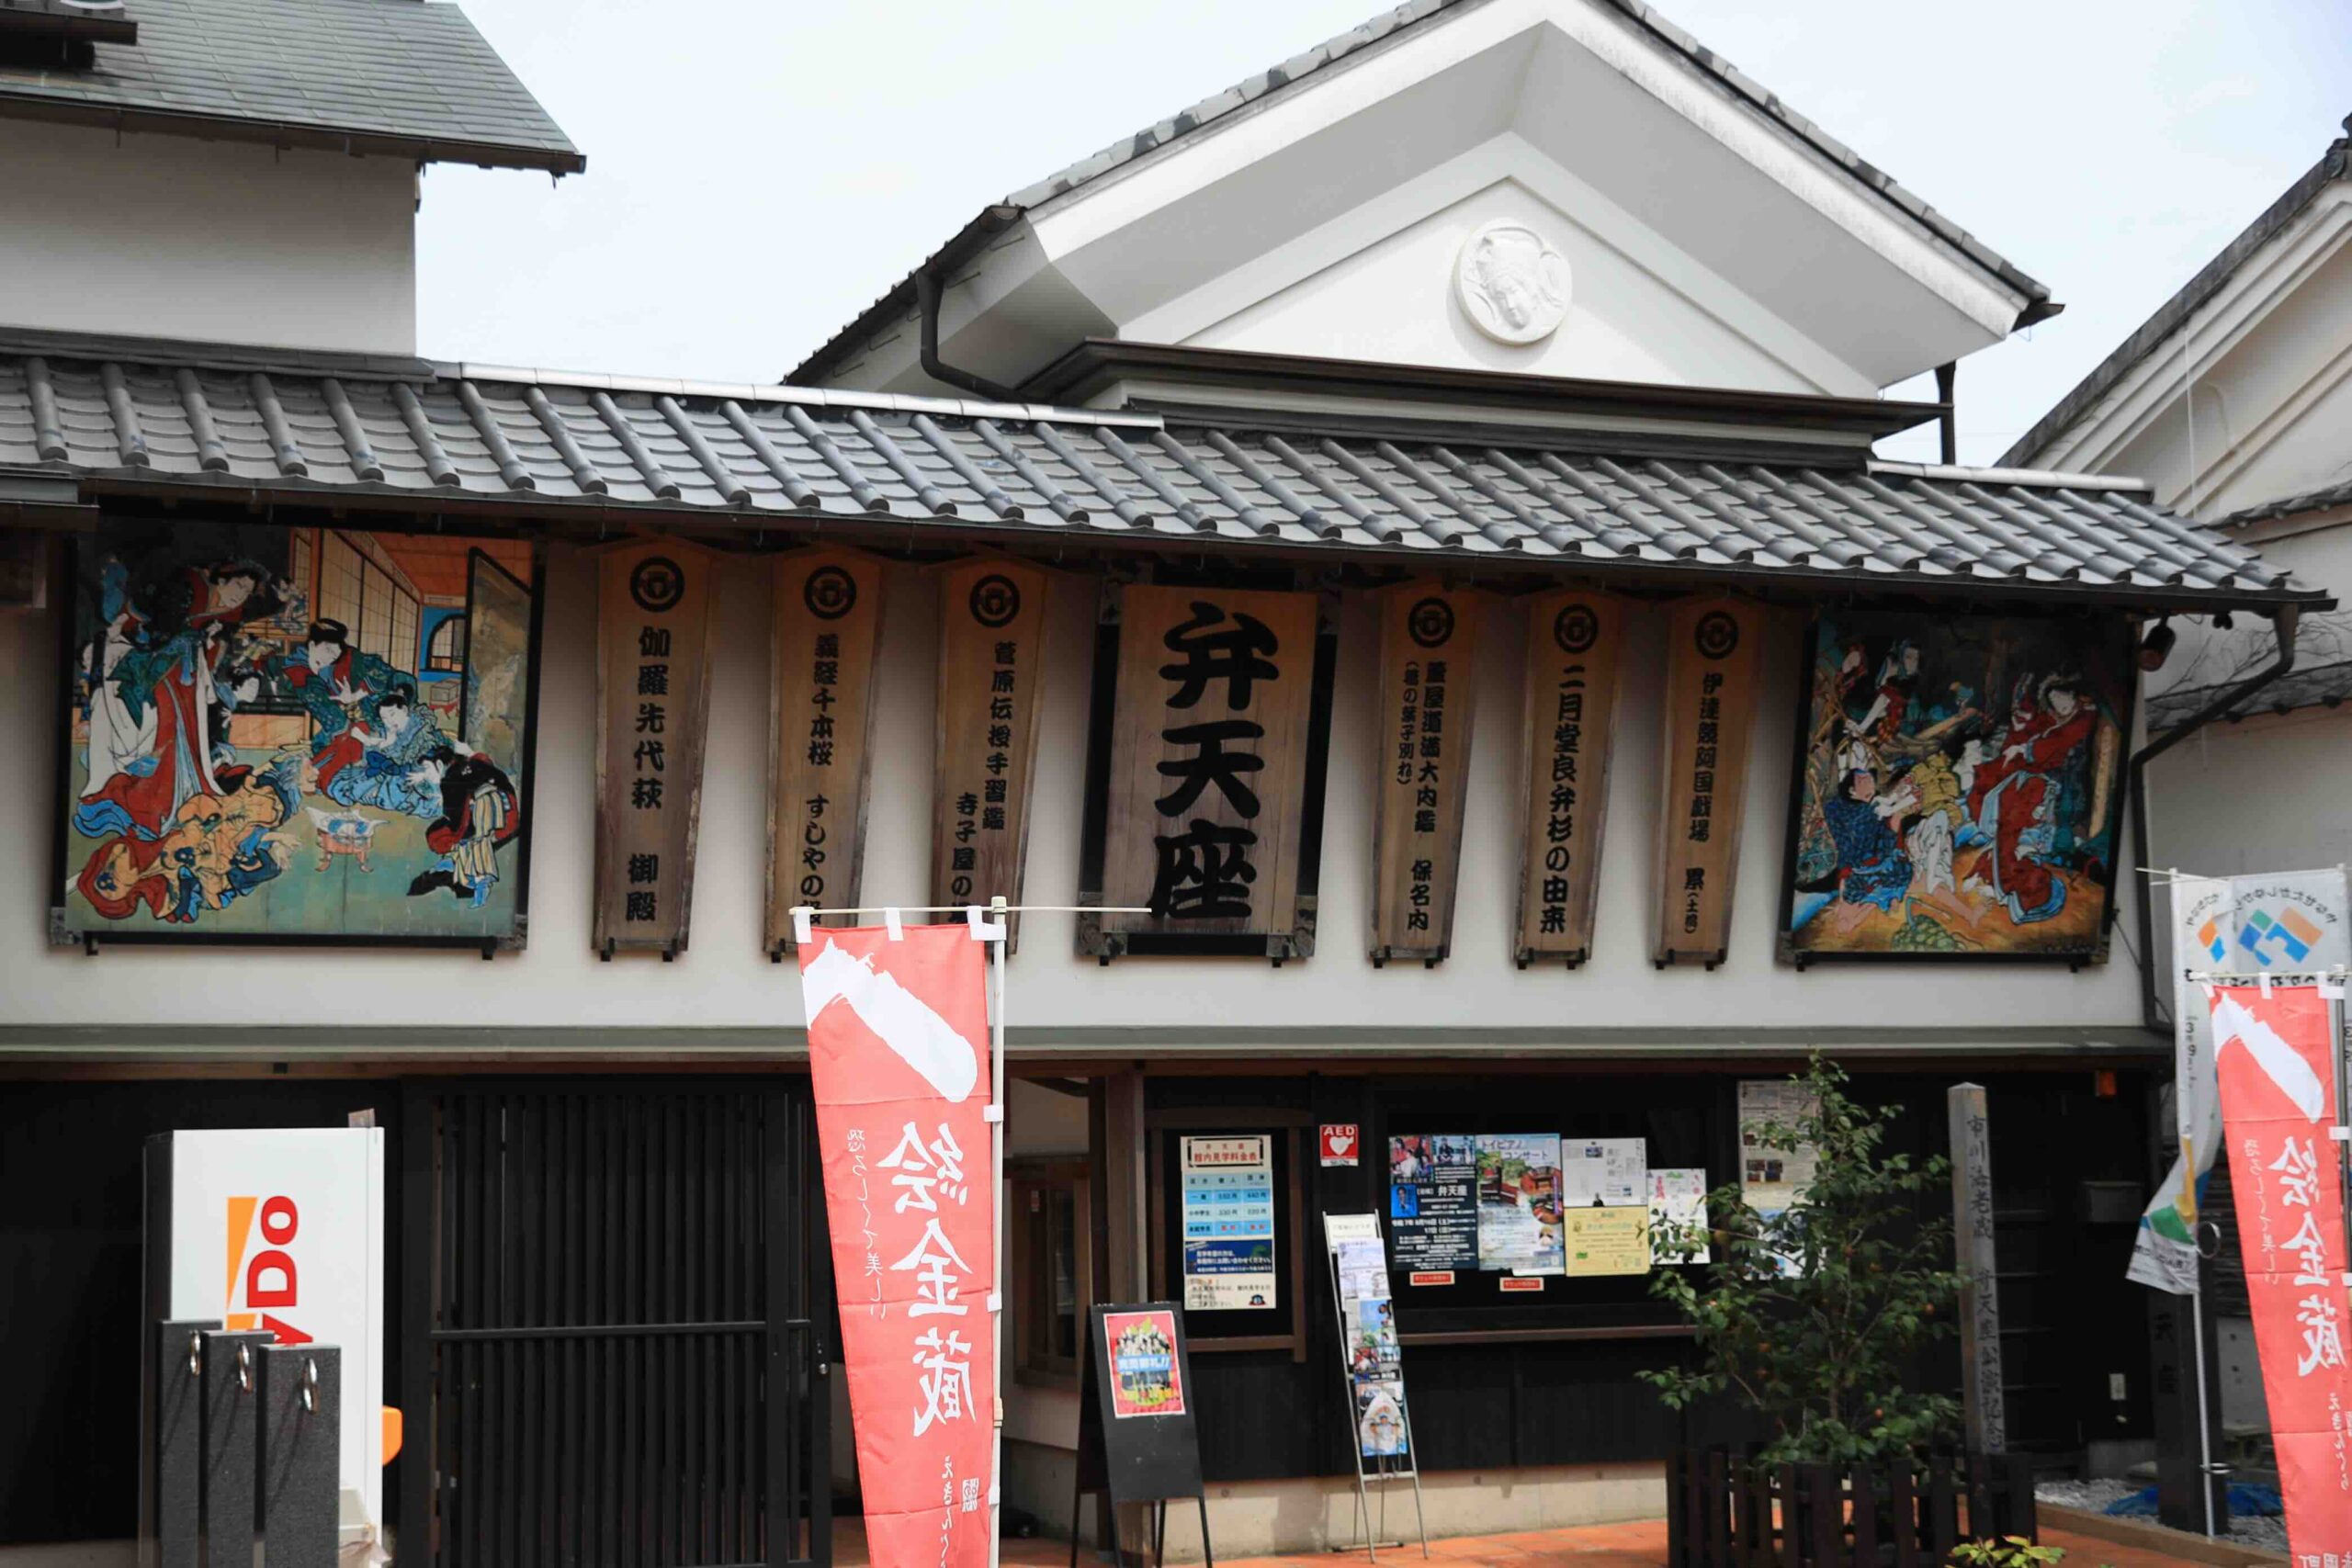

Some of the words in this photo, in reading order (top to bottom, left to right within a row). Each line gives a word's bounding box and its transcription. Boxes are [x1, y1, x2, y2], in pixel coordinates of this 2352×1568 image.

[632, 626, 670, 810] 伽羅先代萩
[982, 641, 1018, 831] 菅原伝授手習鑑
[1148, 600, 1280, 919] 弁天座
[1539, 665, 1587, 935] 二月堂良弁杉の由来
[626, 853, 658, 922] 御殿
[1408, 860, 1432, 931] 保名内
[1324, 1126, 1355, 1136] AED
[1481, 1139, 1522, 1150] トイピアノ
[1504, 1149, 1549, 1160] コンサート
